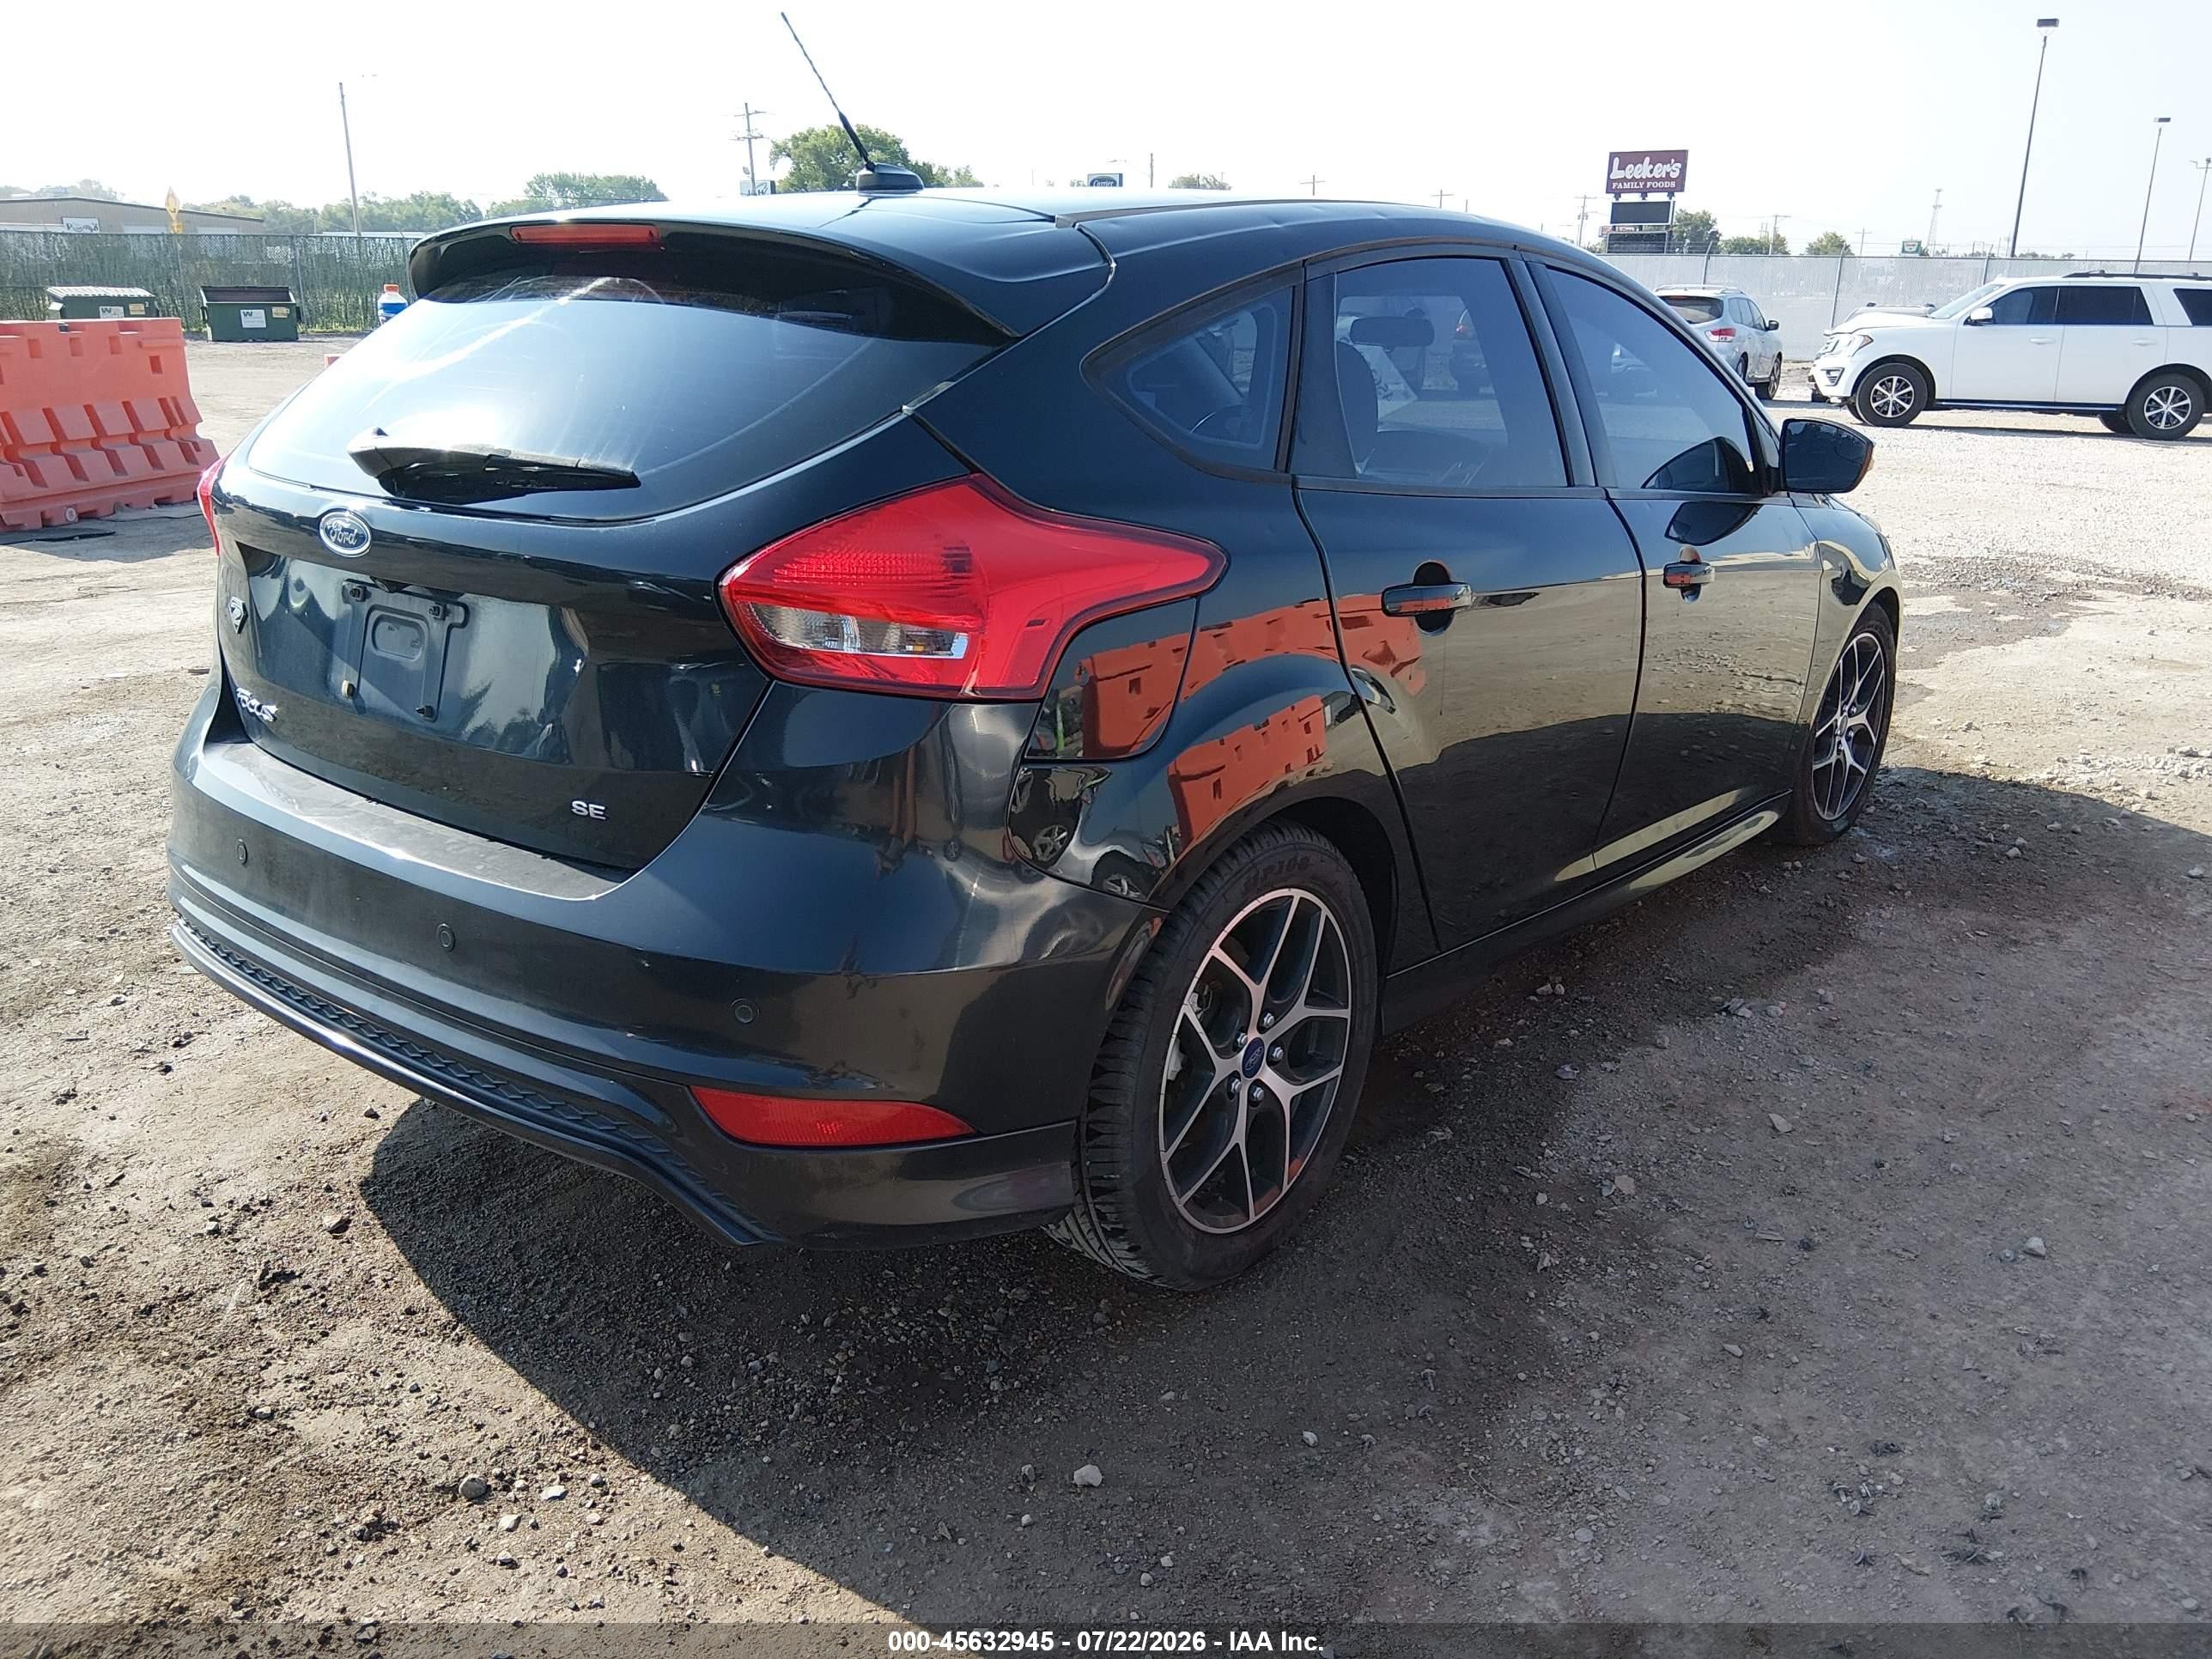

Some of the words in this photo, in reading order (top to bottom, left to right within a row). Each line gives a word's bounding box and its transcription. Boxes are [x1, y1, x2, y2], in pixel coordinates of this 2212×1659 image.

[1610, 156, 1682, 179] Leeker's
[325, 521, 358, 545] Ford
[571, 800, 606, 820] SE
